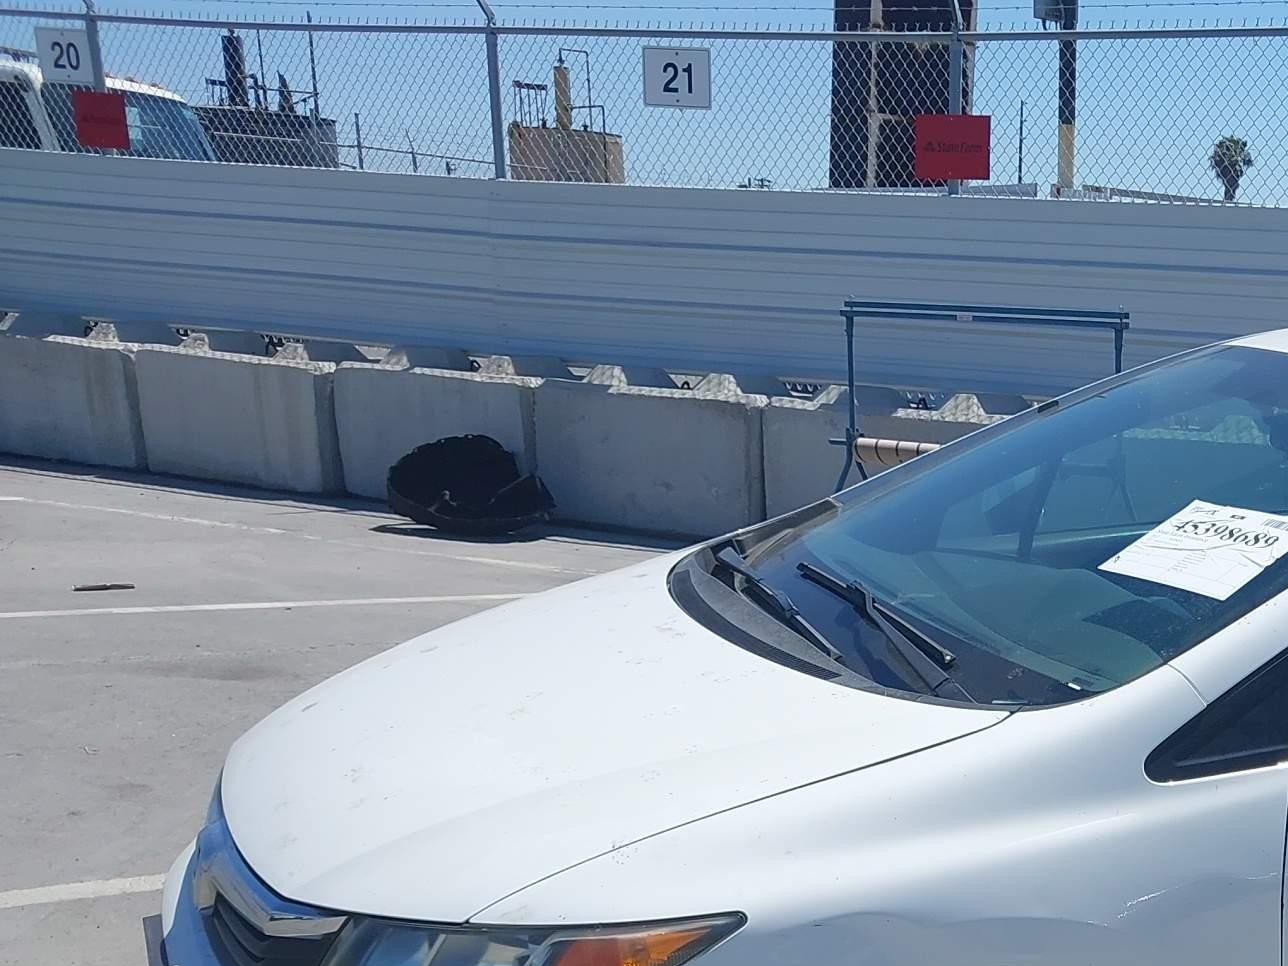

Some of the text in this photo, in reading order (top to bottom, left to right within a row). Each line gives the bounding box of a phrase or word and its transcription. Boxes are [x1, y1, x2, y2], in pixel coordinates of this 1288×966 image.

[50, 41, 81, 71] 20
[662, 61, 694, 94] 21
[1173, 519, 1280, 549] 45398689
